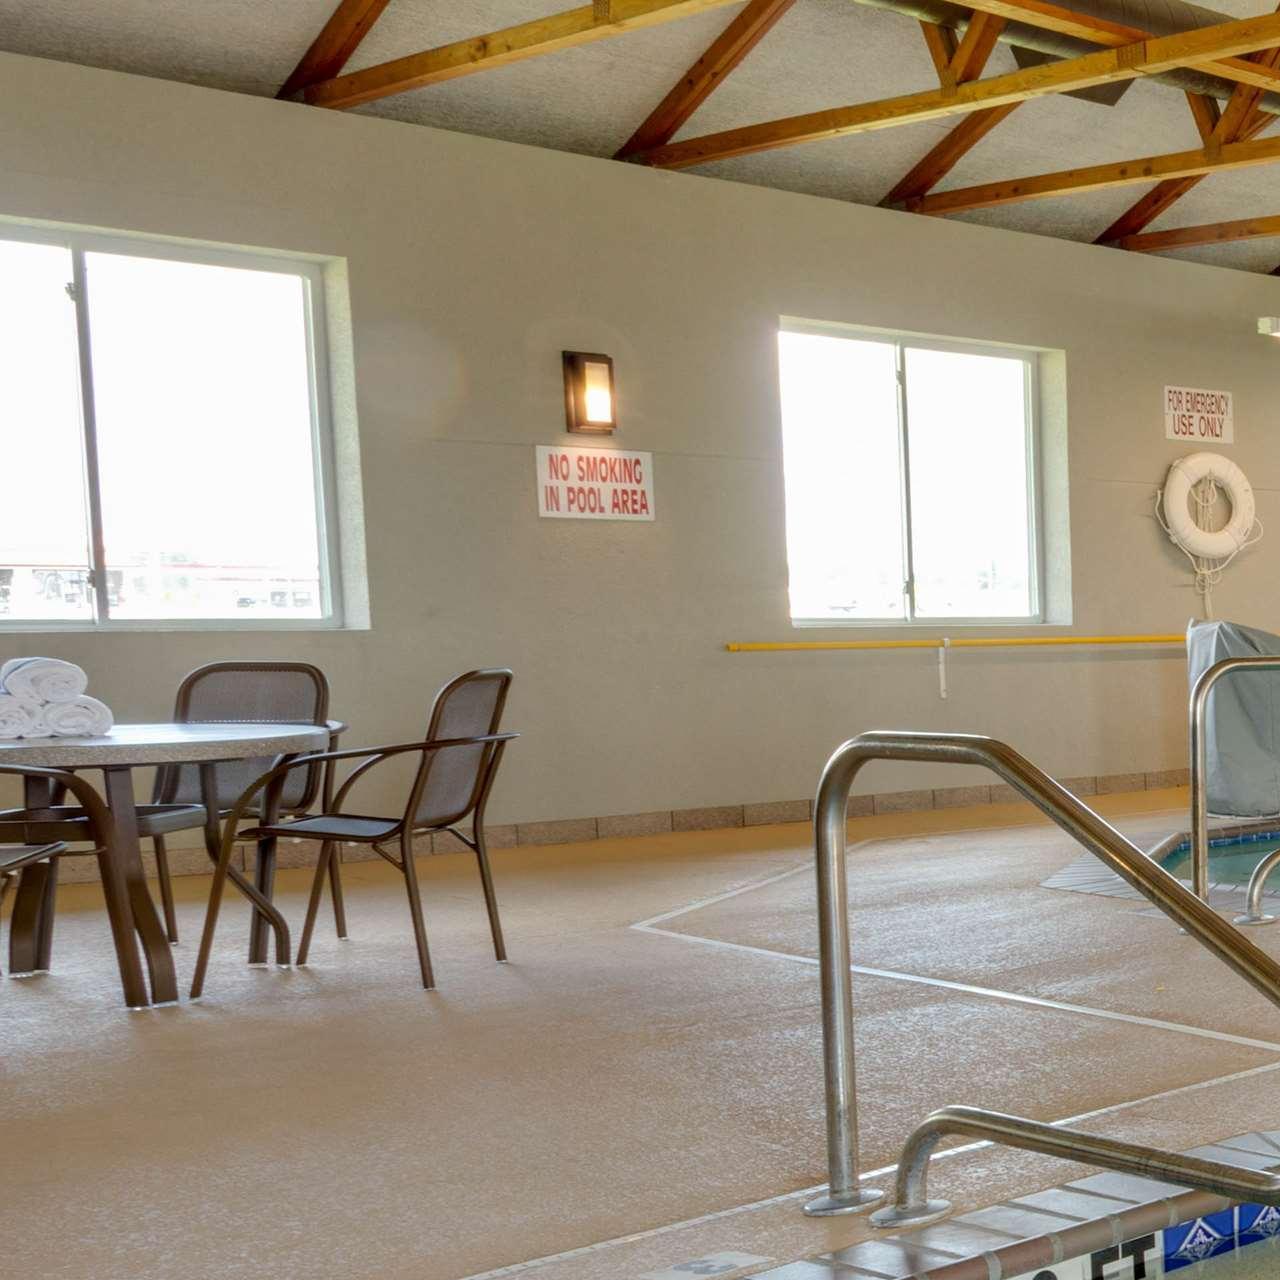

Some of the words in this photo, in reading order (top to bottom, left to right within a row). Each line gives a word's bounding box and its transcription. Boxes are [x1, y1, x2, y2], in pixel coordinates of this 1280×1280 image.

[1168, 390, 1183, 412] FOR
[1185, 391, 1229, 416] EMERGENCY
[1173, 414, 1195, 436] USE
[1199, 415, 1225, 438] ONLY
[548, 453, 570, 481] NO
[576, 455, 643, 485] SMOKING
[544, 485, 561, 512] IN
[566, 486, 606, 513] POOL
[611, 488, 650, 515] AREA
